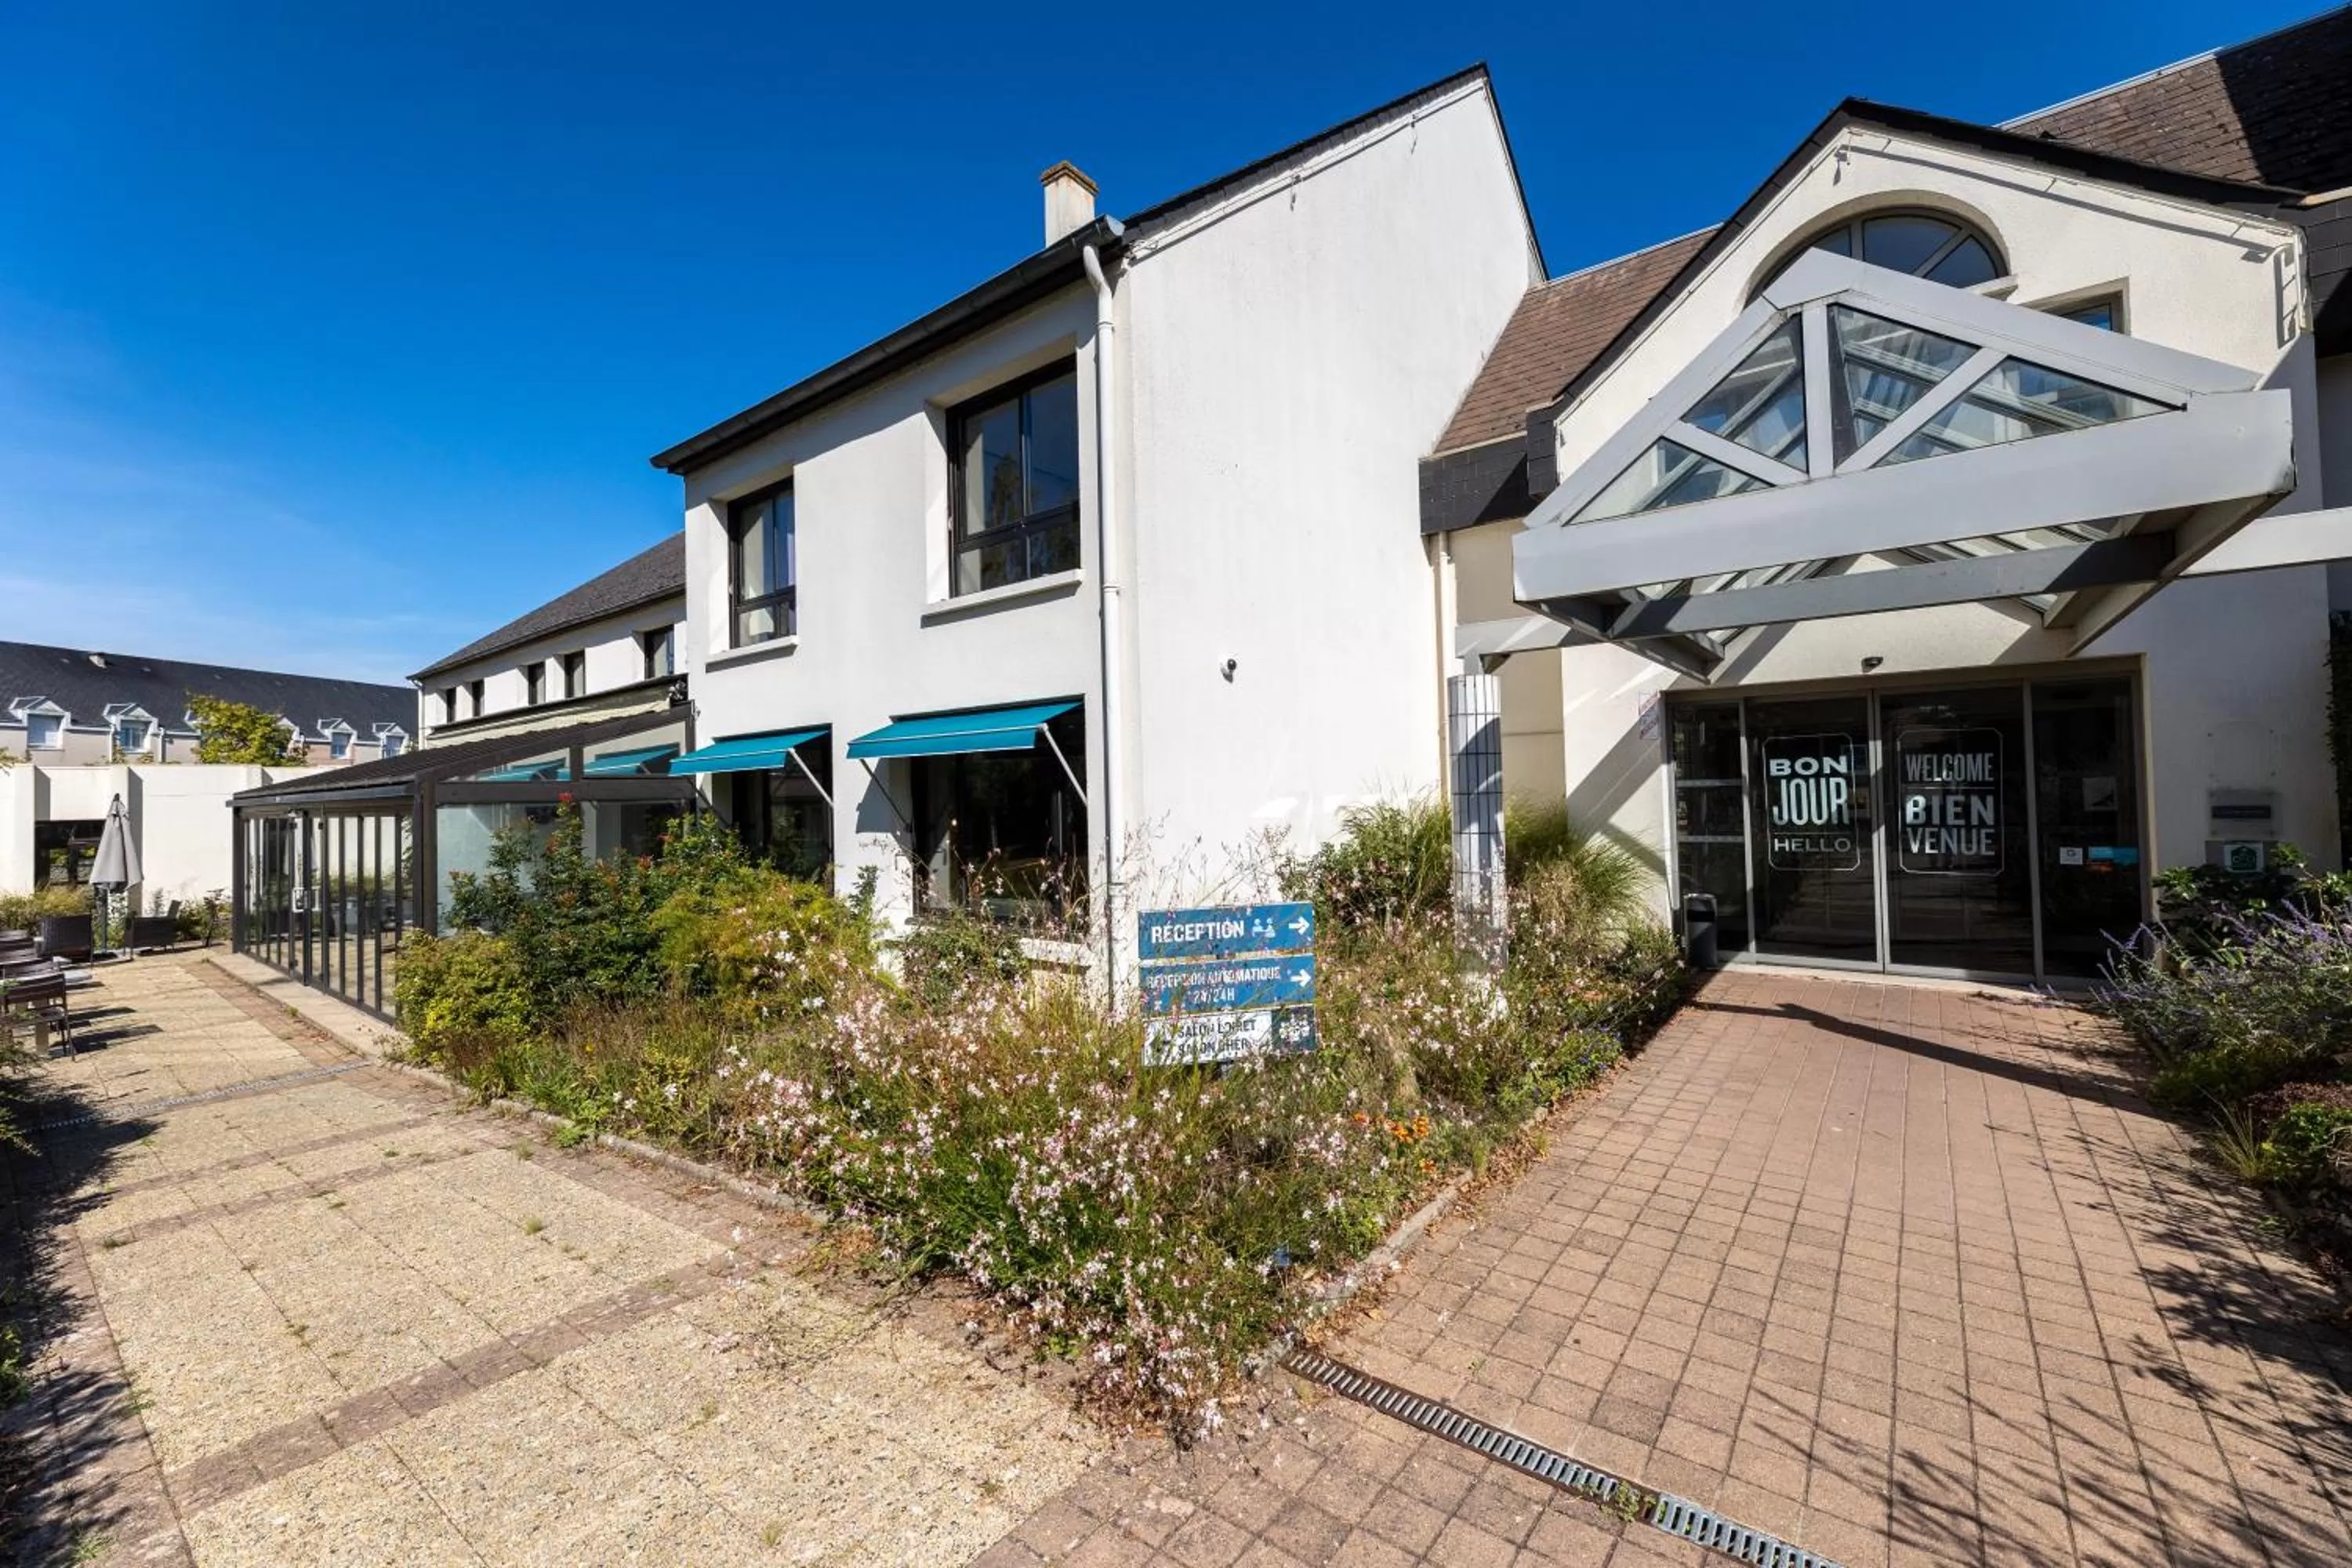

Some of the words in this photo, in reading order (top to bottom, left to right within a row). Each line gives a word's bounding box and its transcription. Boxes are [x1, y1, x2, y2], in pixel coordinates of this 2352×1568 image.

[1769, 756, 1847, 776] BON
[1905, 753, 1994, 782] WELCOME
[1773, 777, 1850, 826] JOUR
[1905, 794, 1995, 826] BIEN
[1774, 838, 1851, 852] HELLO
[1906, 827, 1995, 856] VENUE
[1151, 920, 1245, 944] RÉCEPTION
